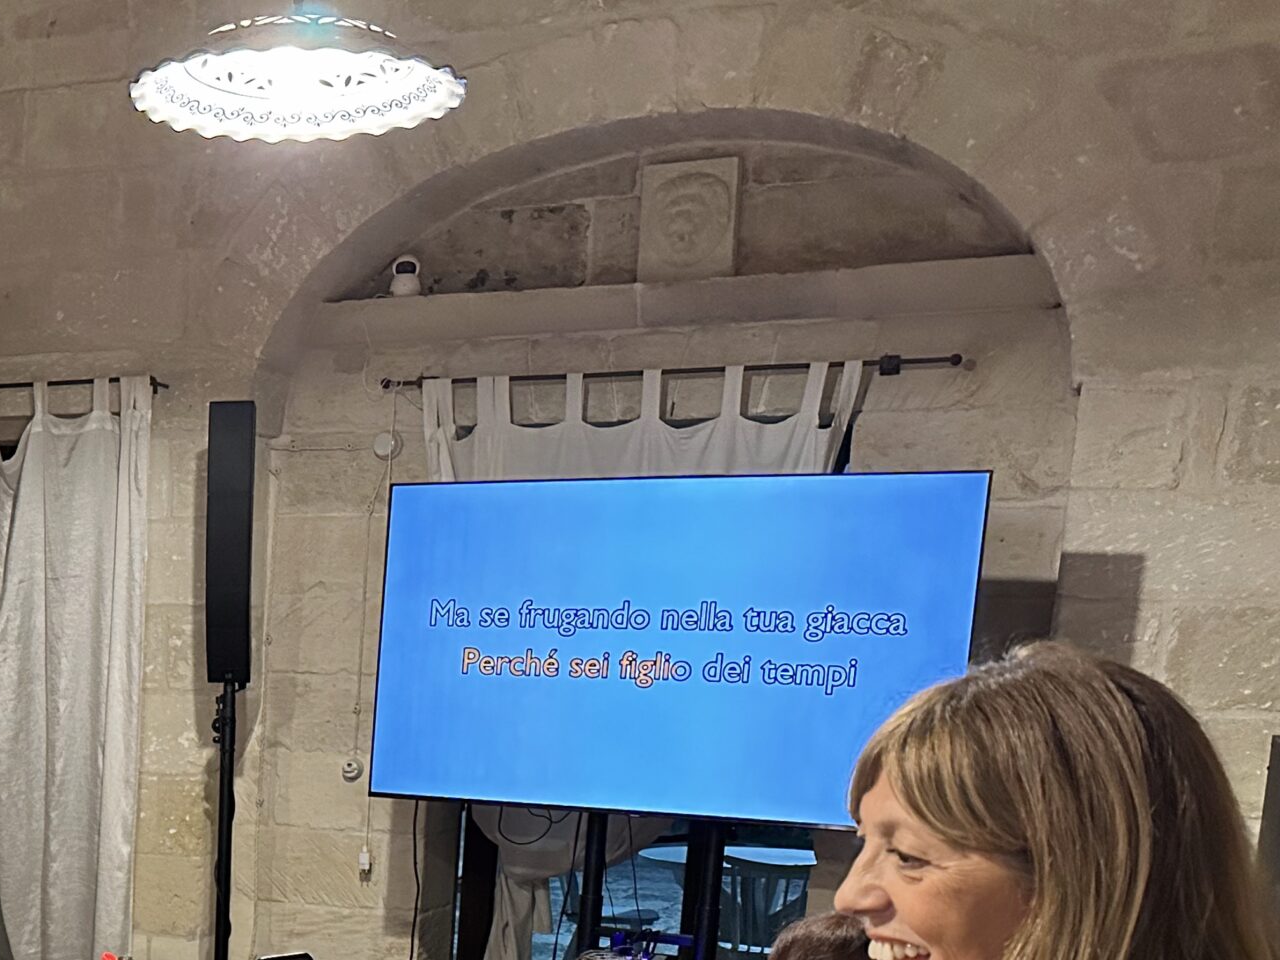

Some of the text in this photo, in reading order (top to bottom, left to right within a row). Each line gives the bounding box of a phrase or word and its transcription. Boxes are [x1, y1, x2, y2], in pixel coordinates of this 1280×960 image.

[429, 599, 908, 642] Ma se frugando nella tua giacca
[461, 647, 858, 695] Perché sei figlio dei tempi
